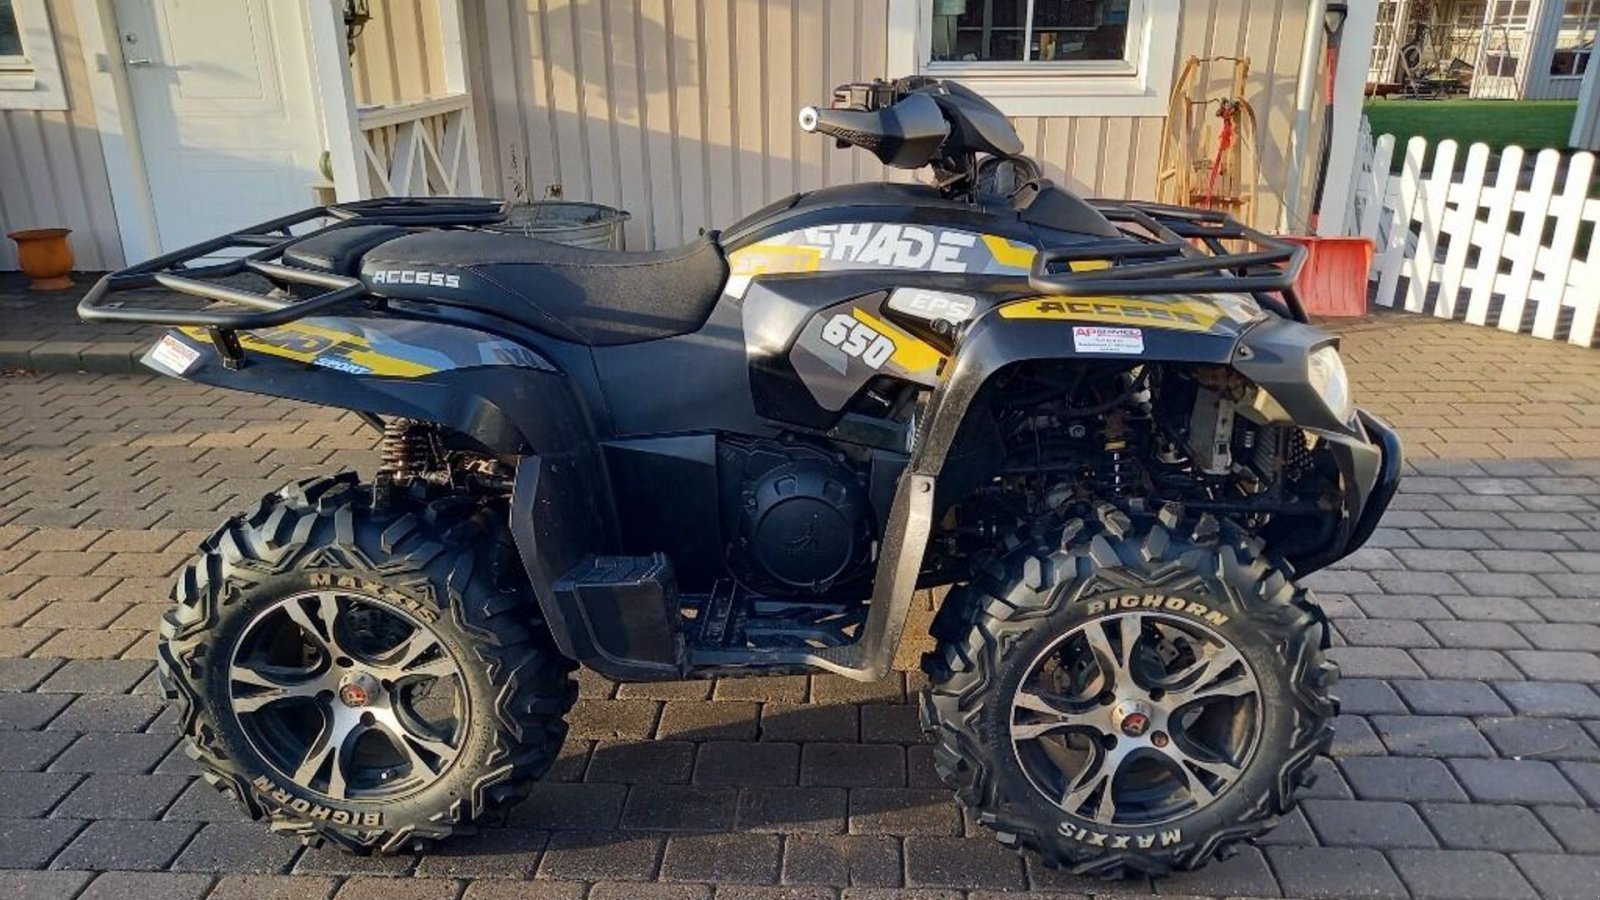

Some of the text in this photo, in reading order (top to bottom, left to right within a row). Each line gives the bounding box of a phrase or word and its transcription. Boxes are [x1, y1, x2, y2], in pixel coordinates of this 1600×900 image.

[801, 222, 976, 273] SHADE
[372, 270, 461, 289] ACCESS
[909, 292, 968, 319] EPS
[1035, 301, 1201, 325] ACCESS
[821, 314, 896, 370] 650
[309, 573, 440, 624] MAXXIS
[1087, 594, 1229, 626] BIGHORN
[253, 775, 381, 827] BIGHORN
[1057, 821, 1182, 849] MAXXIS
